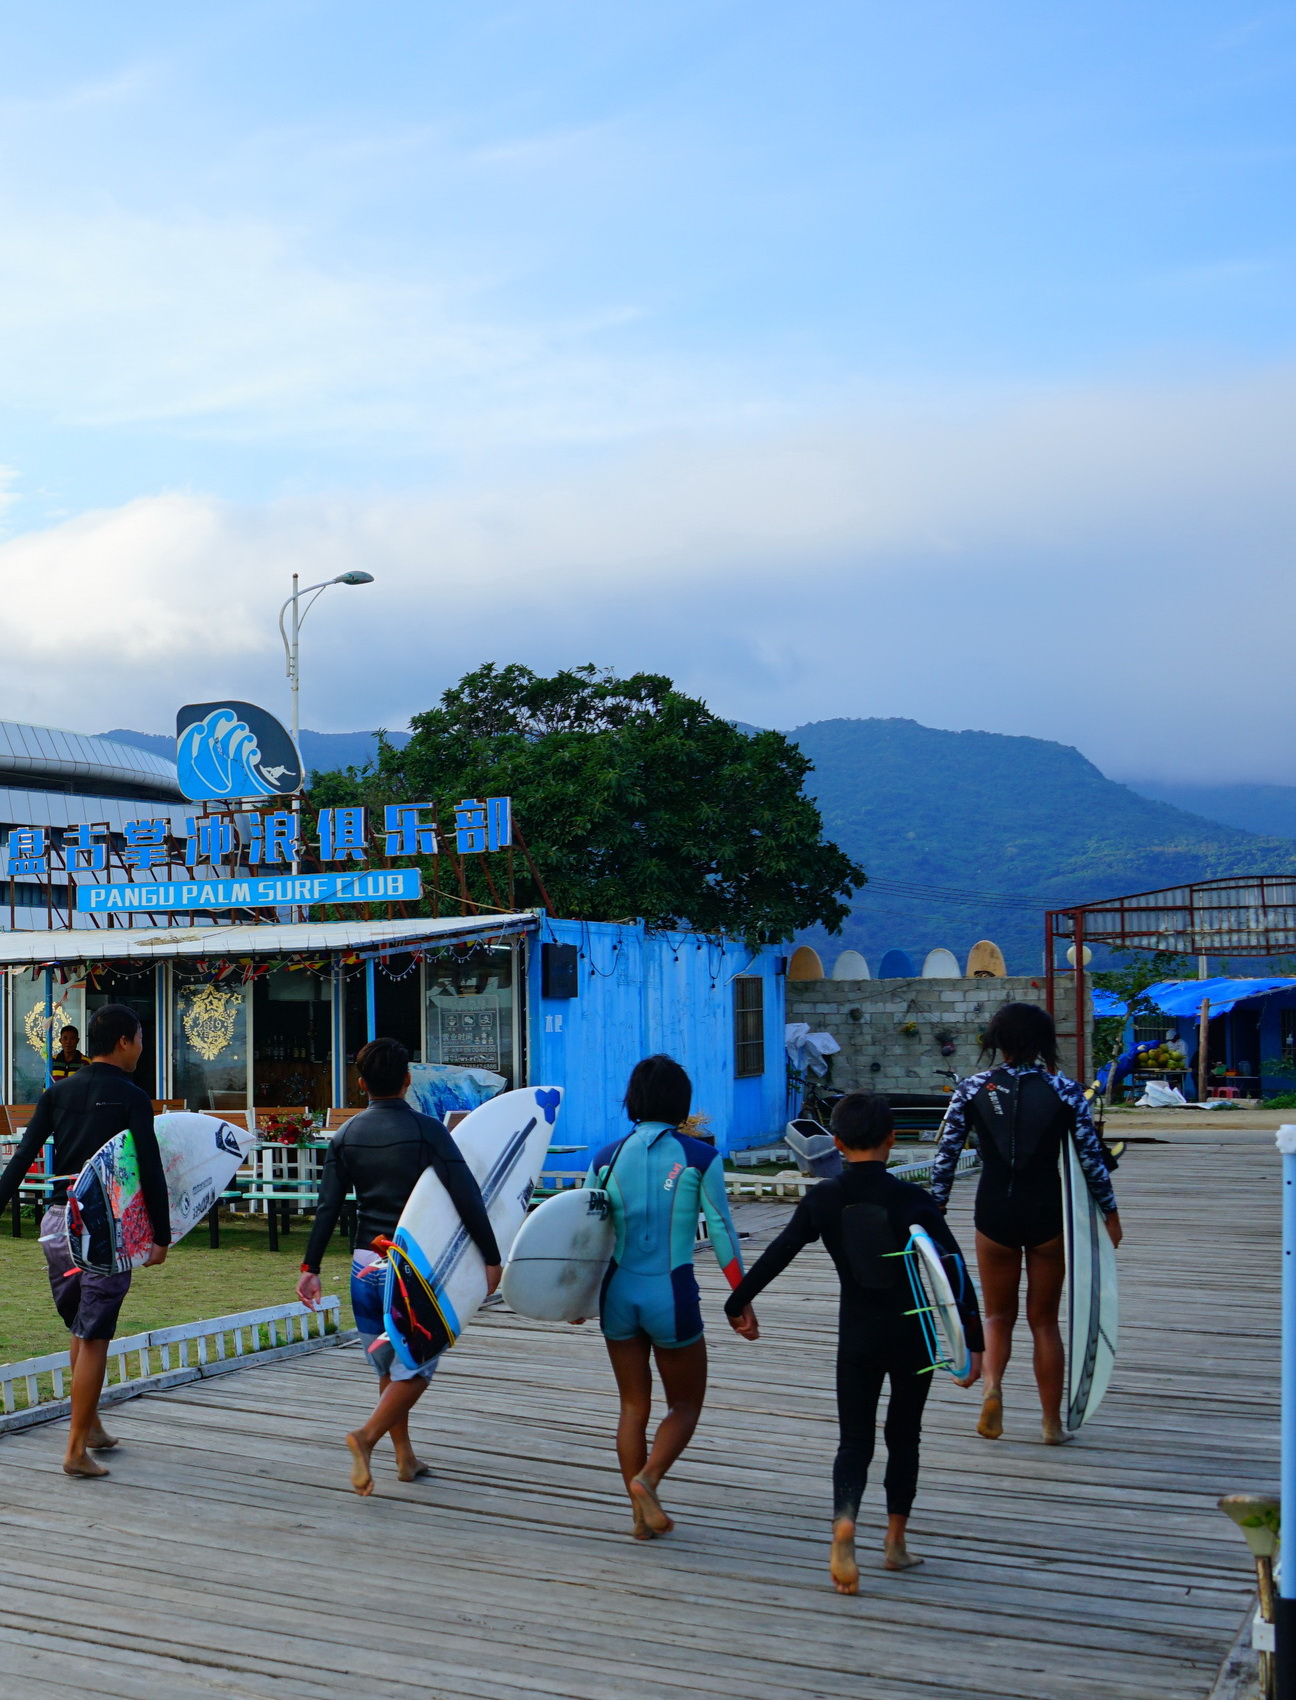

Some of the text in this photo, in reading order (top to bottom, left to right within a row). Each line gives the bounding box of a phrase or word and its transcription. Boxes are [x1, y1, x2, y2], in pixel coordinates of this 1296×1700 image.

[5, 796, 513, 877] 盘古掌冲浪俱乐部
[89, 874, 405, 909] PANGU PALM SURF CLUB
